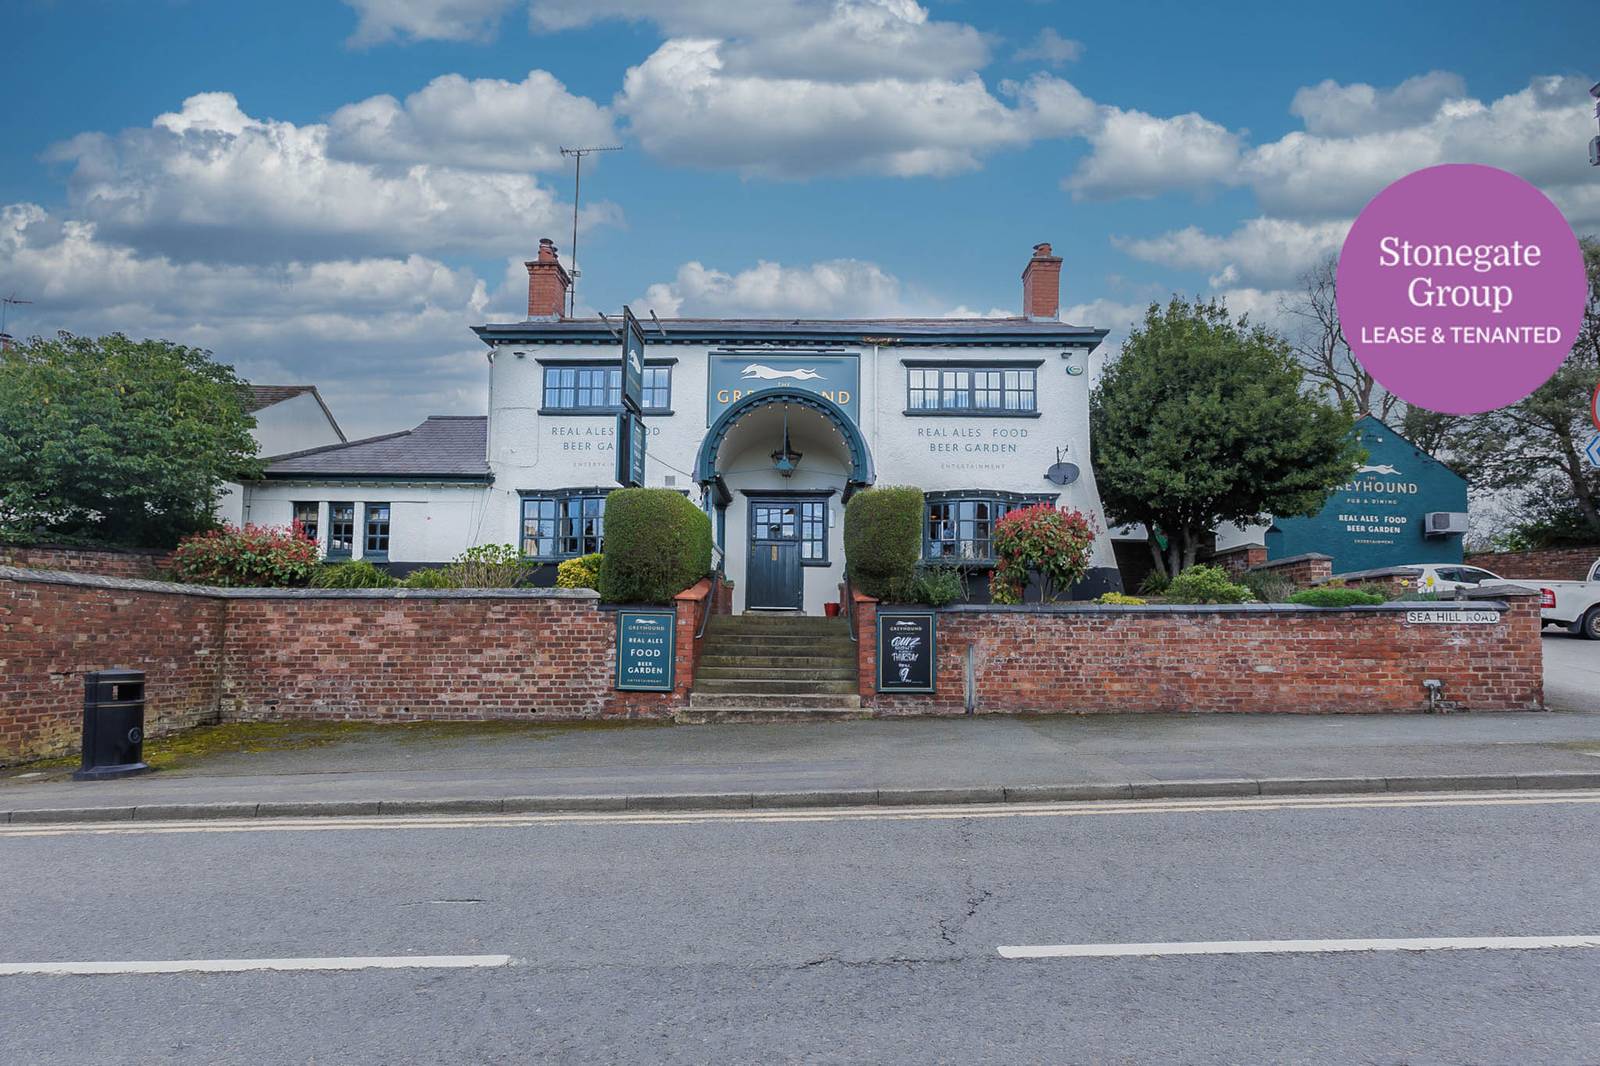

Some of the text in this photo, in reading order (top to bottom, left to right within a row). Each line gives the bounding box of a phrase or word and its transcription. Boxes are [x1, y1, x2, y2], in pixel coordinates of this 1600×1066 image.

[551, 427, 583, 436] REAL
[586, 427, 614, 436] ALES
[918, 428, 1028, 438] REAL ALES FOOD
[563, 442, 591, 451] BEER
[930, 443, 1017, 453] BEER GARDEN
[1339, 514, 1407, 524] REAL ALES FOOD
[1368, 526, 1400, 534] GARDEN
[1409, 612, 1497, 622] SEA HILL ROAD
[630, 648, 661, 657] FOOD
